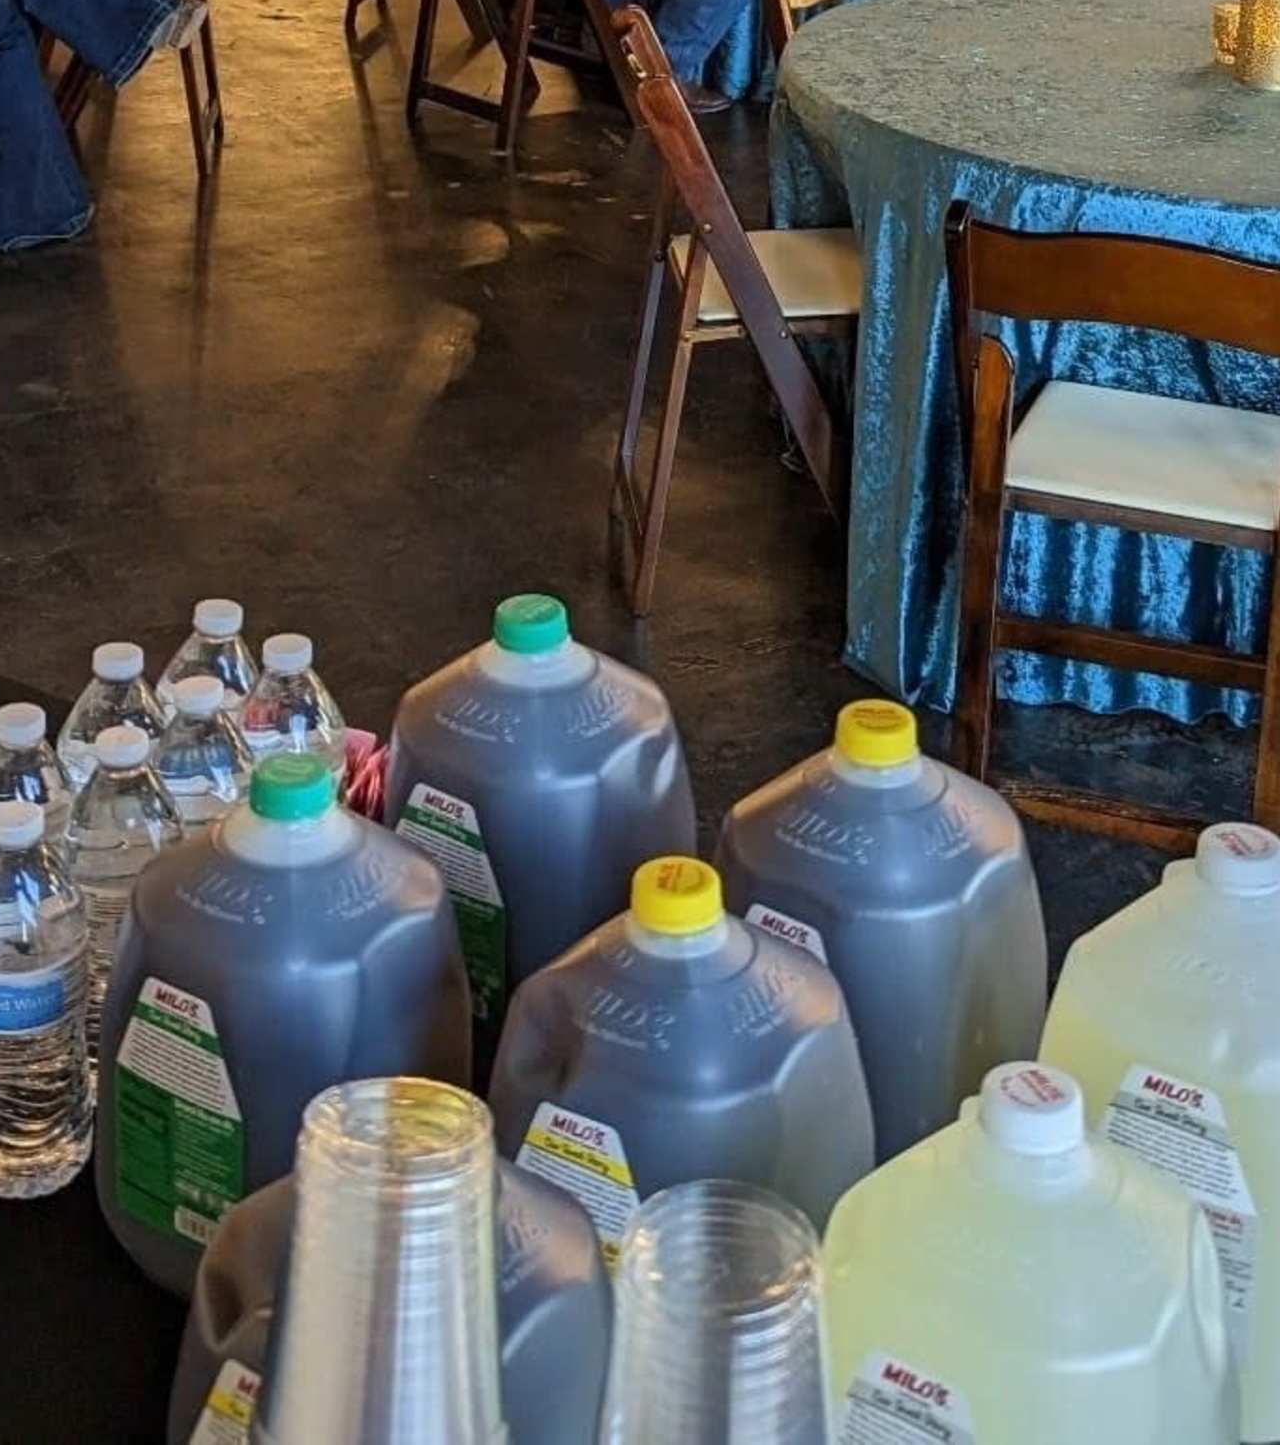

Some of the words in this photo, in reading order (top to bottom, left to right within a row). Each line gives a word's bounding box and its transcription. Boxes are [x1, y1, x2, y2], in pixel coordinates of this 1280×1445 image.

[424, 792, 465, 818] MILO'S
[762, 913, 809, 944] MILO'S
[155, 987, 199, 1017] MILO'S
[1142, 1074, 1204, 1108] MILO'S
[550, 1113, 606, 1147] MILO'S
[881, 1361, 950, 1407] MILO'S
